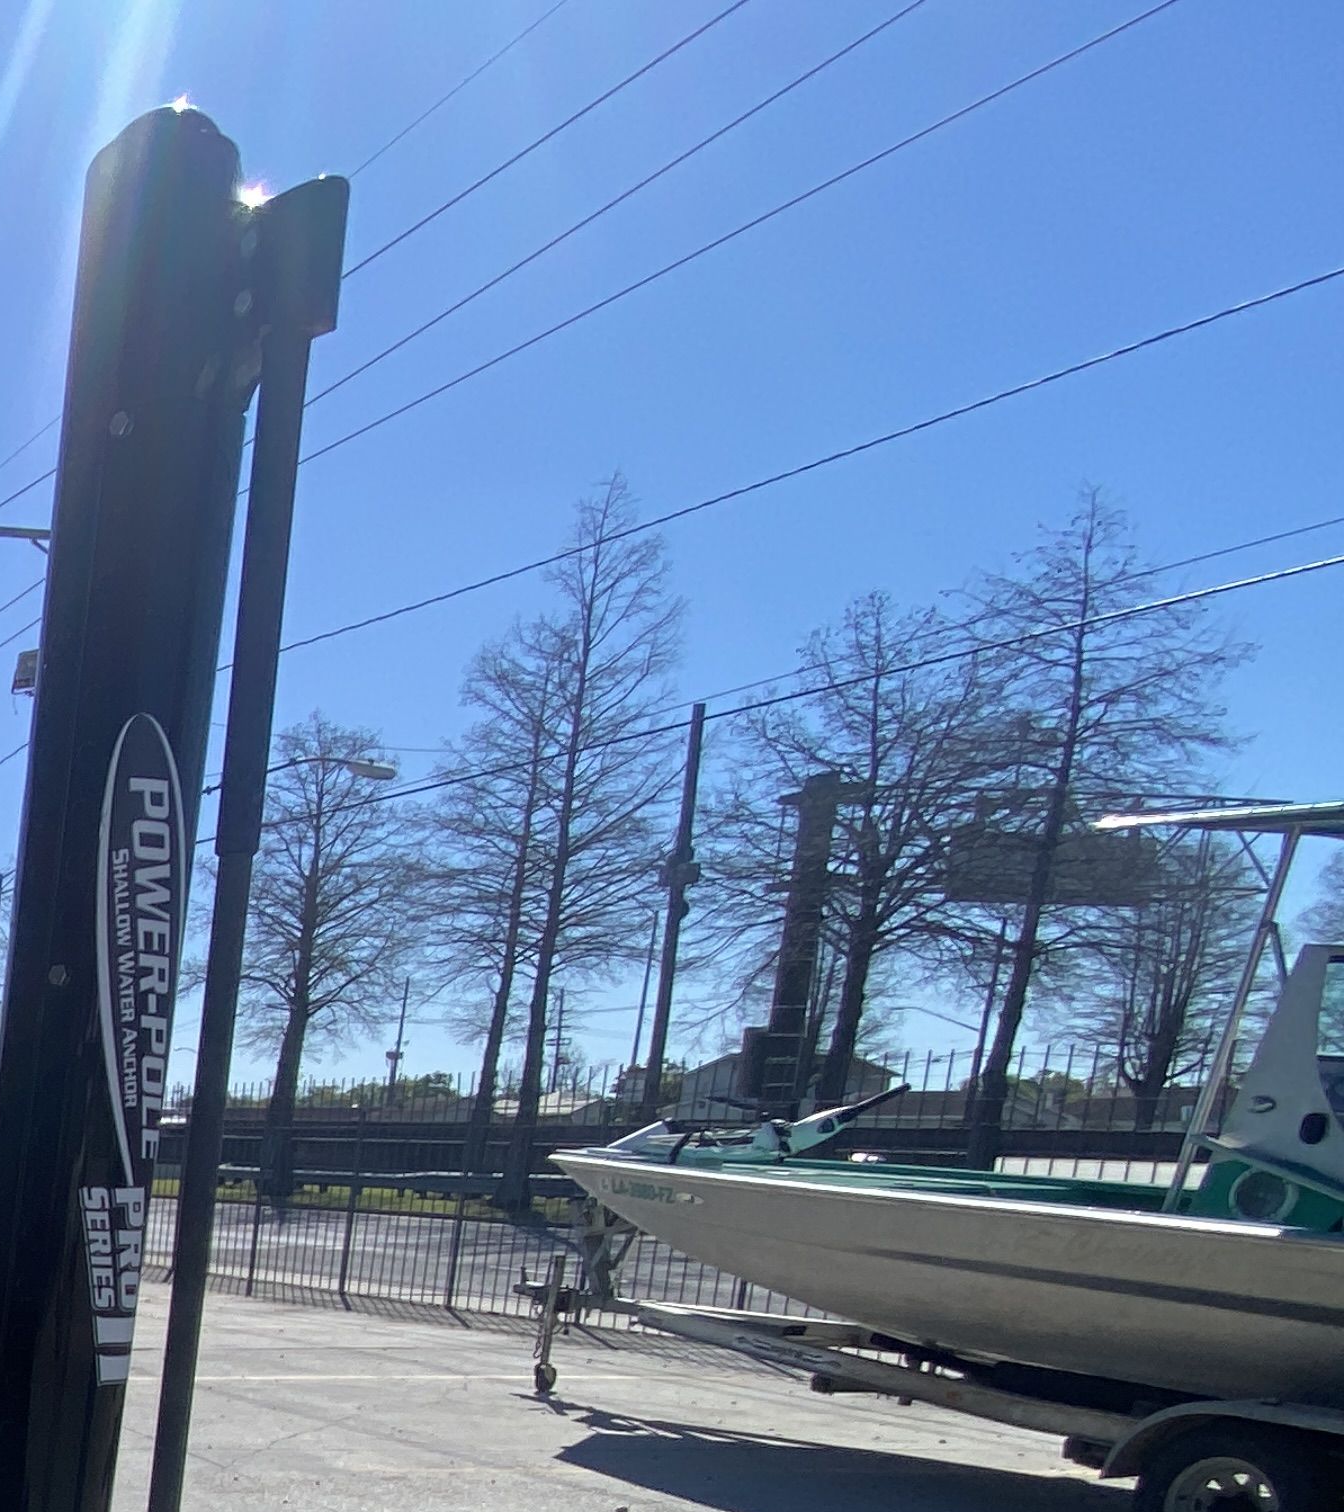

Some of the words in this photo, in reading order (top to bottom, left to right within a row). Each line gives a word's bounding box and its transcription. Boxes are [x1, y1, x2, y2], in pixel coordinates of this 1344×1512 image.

[112, 848, 133, 947] SHALLOW
[116, 950, 137, 1023] WATER
[128, 776, 172, 1160] POWER-POLE
[120, 1027, 138, 1109] ANCHOR
[80, 1186, 116, 1309] SERIES
[114, 1186, 146, 1313] PRO
